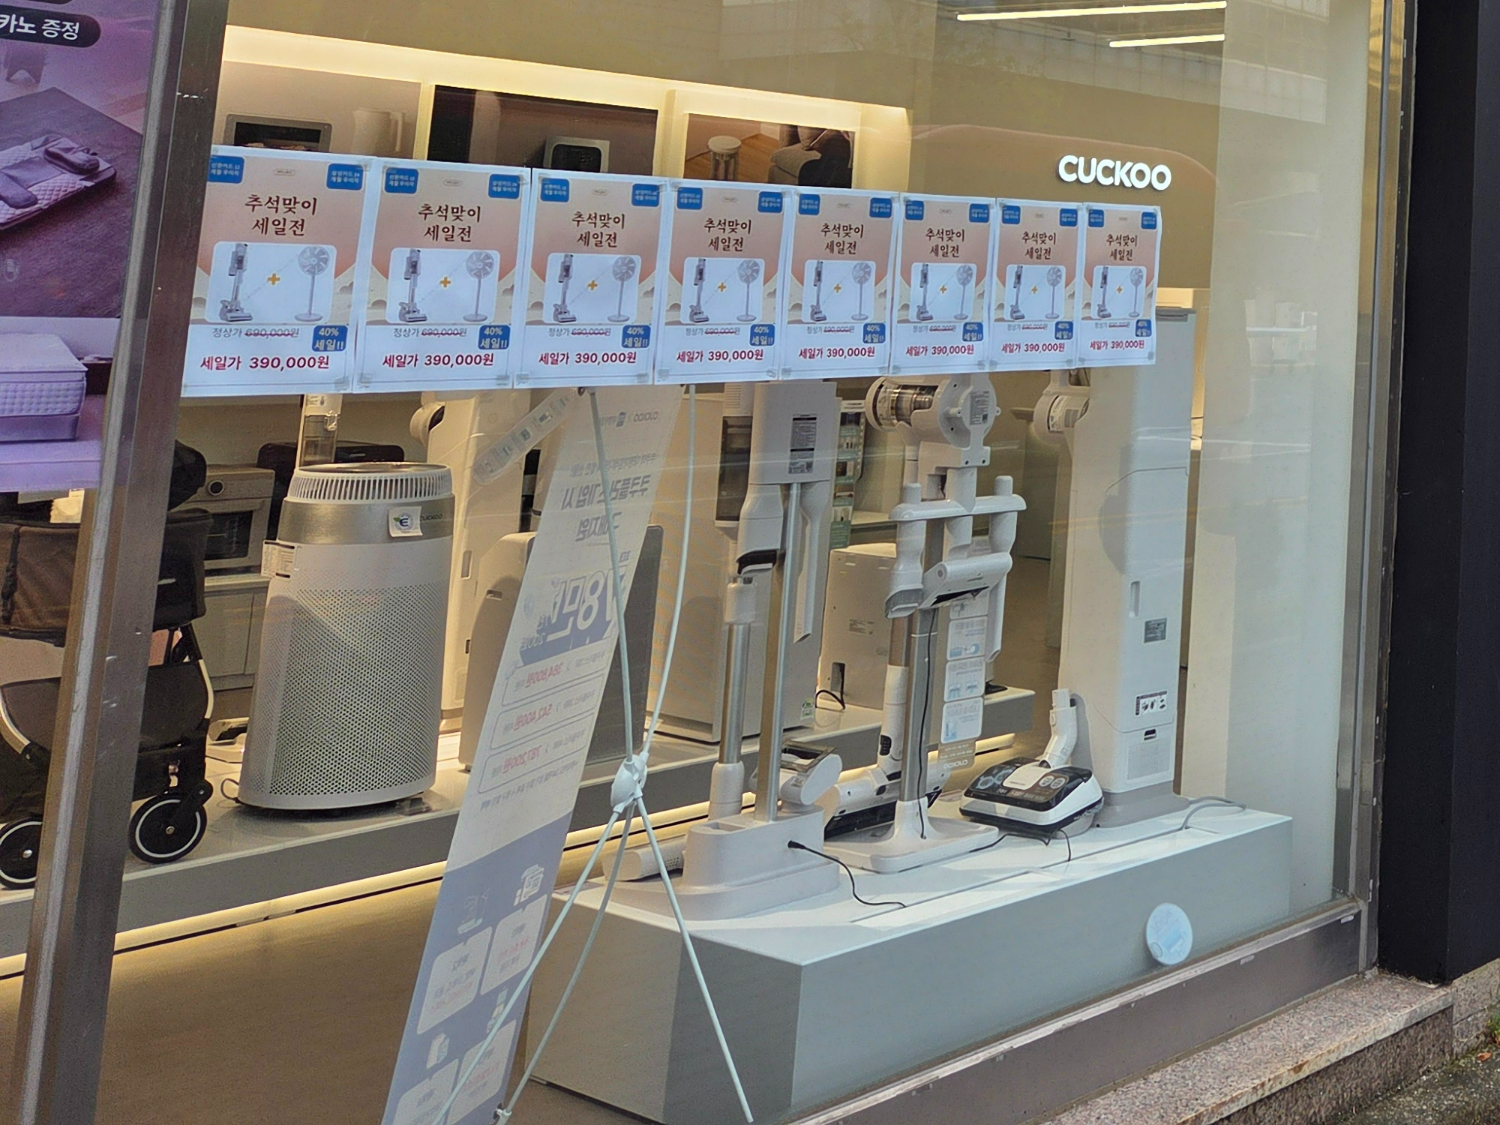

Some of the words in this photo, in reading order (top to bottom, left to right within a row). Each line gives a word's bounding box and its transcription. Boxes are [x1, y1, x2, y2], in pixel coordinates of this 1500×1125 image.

[42, 18, 80, 41] 증정
[1058, 155, 1172, 191] CUCKOO
[245, 194, 317, 215] 추석맞이
[418, 204, 481, 222] 추석맞이
[572, 211, 625, 229] 추석맞이
[252, 217, 305, 236] 세일전
[424, 225, 471, 242] 세일전
[704, 218, 751, 235] 추석맞이
[821, 223, 864, 238] 추석맞이
[577, 231, 617, 248] 세일전
[925, 228, 965, 242] 추석맞이
[708, 237, 744, 252] 세일전
[825, 240, 856, 255] 세일전
[929, 244, 960, 258] 세일전
[212, 327, 242, 338] 정상가
[319, 327, 339, 336] 40%
[484, 327, 502, 335] 40%
[677, 350, 703, 363] 세일가
[708, 349, 763, 361] 390,000원
[799, 347, 823, 359] 세일가
[827, 346, 875, 359] 390,000원
[906, 345, 928, 357] 세일가
[931, 344, 975, 357] 390,000원
[1001, 343, 1021, 353] 세일가
[1024, 343, 1065, 354] 390,000원
[200, 356, 241, 370] 세일가
[249, 355, 329, 371] 390,000원
[383, 354, 418, 367] 세일가
[424, 353, 493, 368] 390,000원
[539, 352, 569, 365] 세일가
[575, 351, 636, 366] 390,000원
